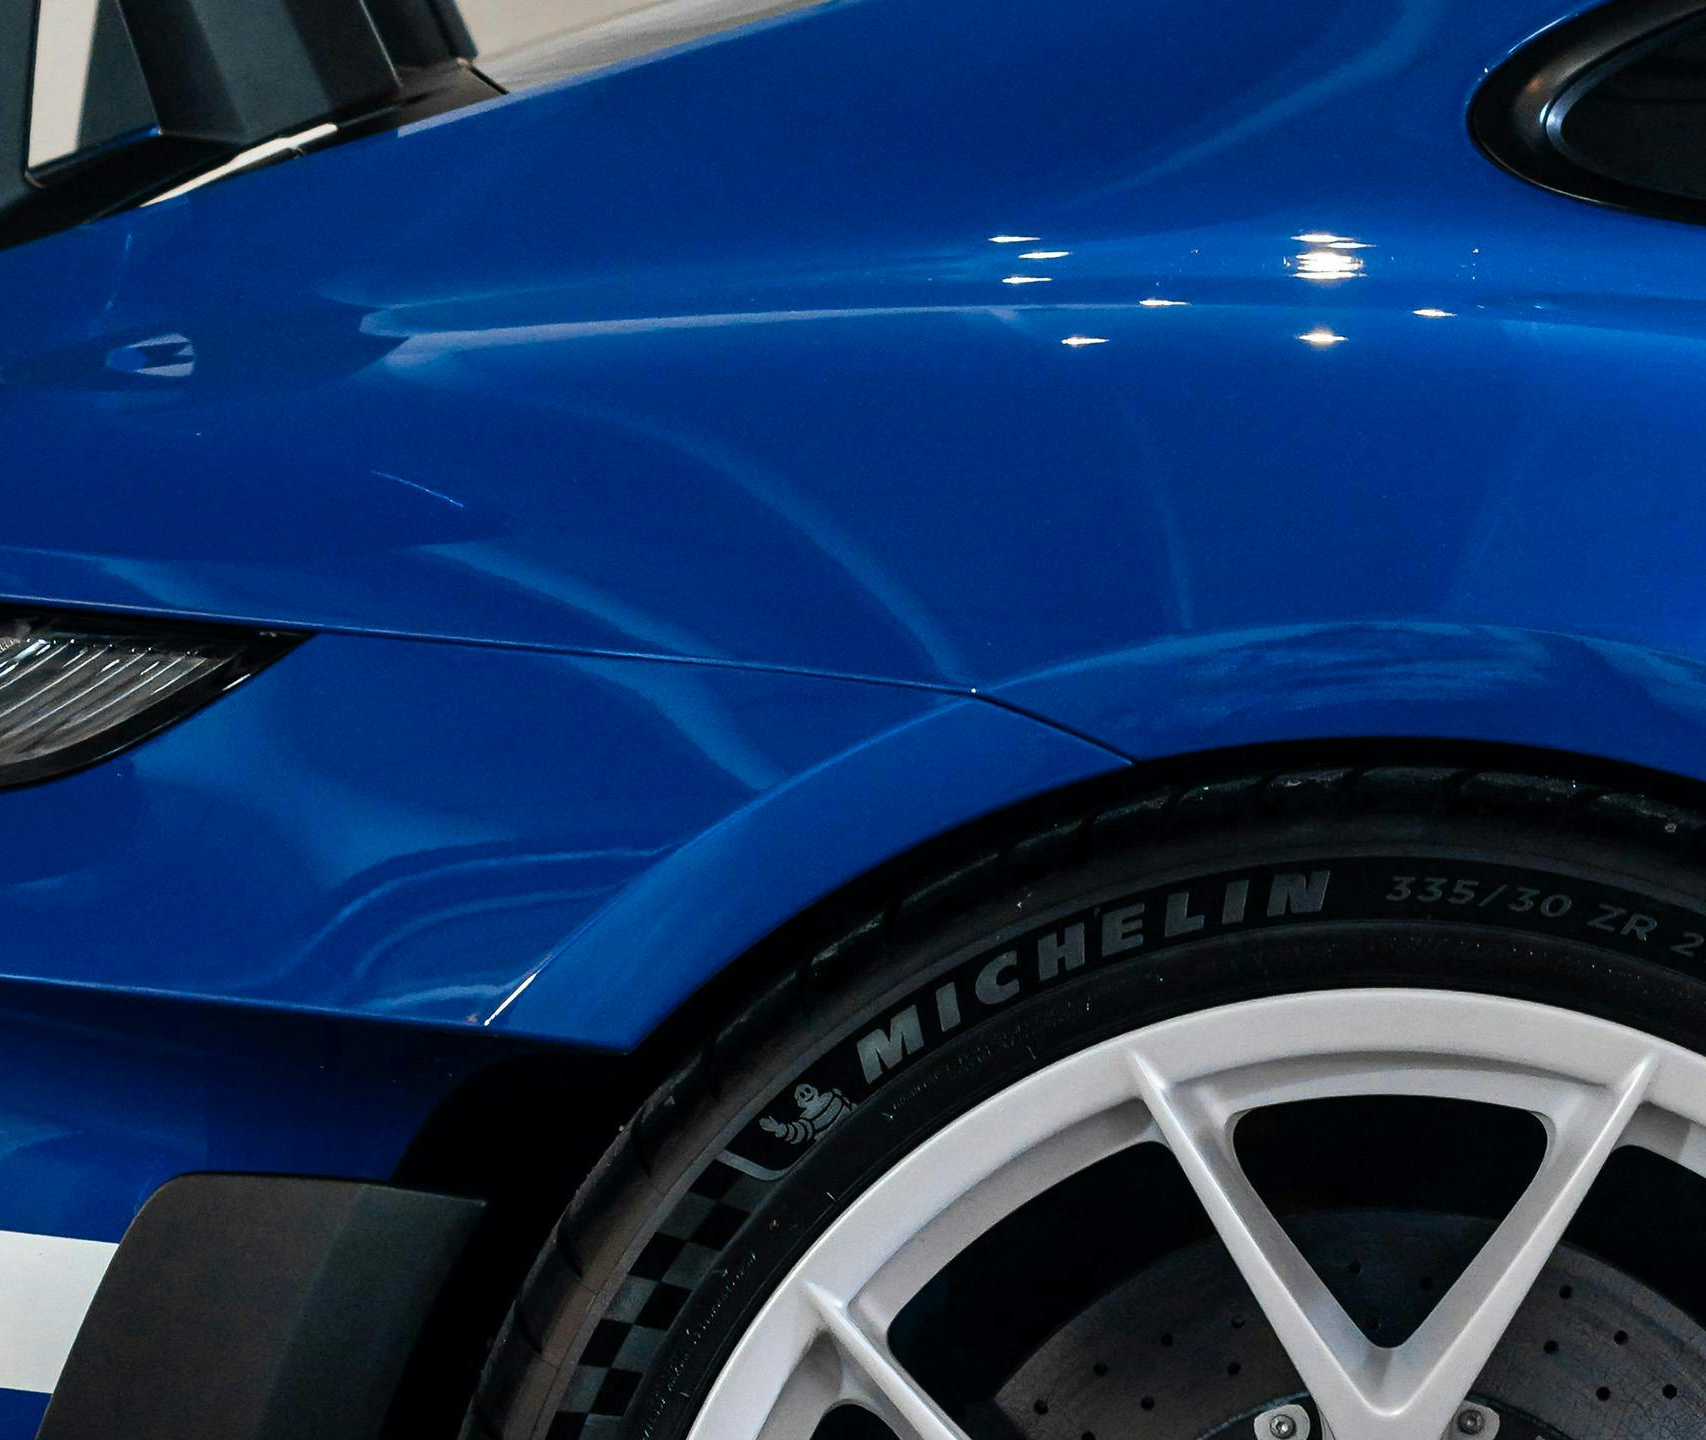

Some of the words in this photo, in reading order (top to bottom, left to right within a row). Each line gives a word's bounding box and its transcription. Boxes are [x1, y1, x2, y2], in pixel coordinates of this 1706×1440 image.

[856, 869, 1332, 1084] MICHELIN
[1383, 873, 1574, 920] 335/30
[1585, 899, 1659, 942] ZR
